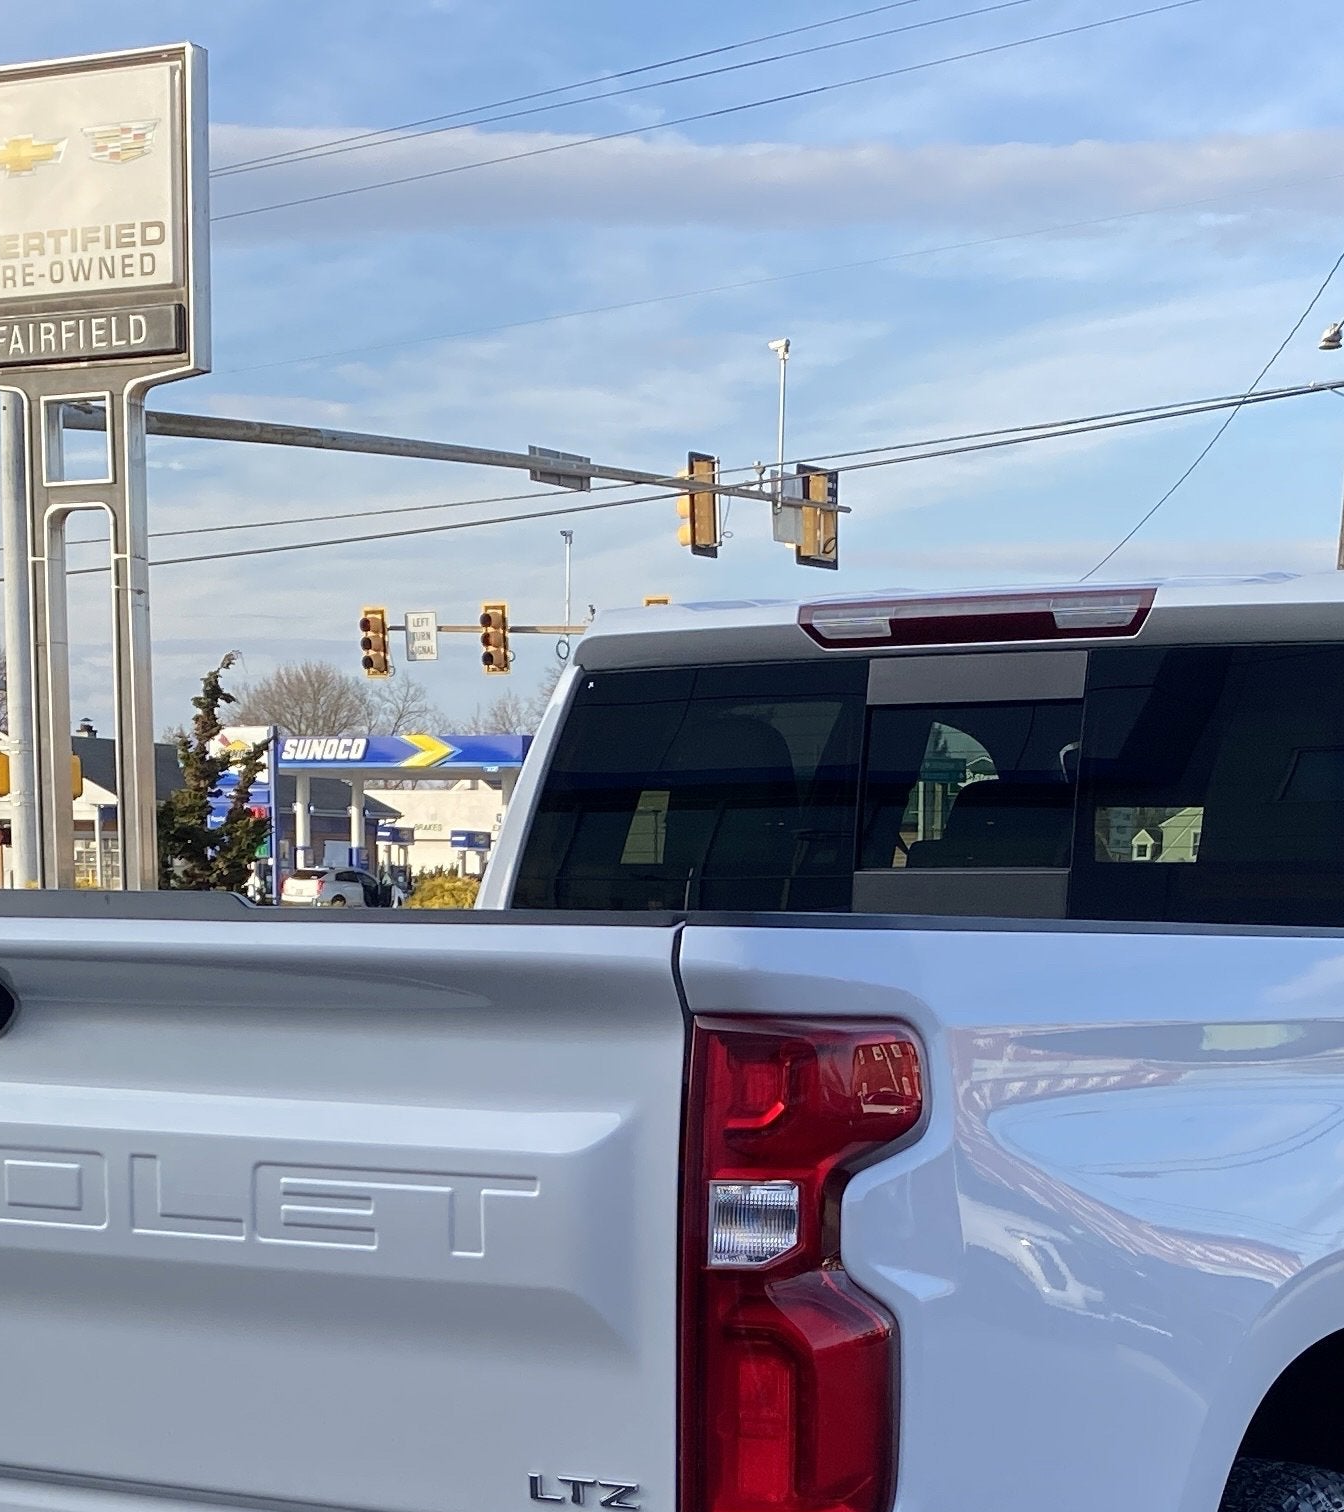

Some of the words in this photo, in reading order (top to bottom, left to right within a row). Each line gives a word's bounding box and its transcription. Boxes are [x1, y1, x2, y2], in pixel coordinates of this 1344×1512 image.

[412, 617, 430, 628] LEFT
[411, 631, 431, 641] TURN
[281, 738, 368, 761] SUNOCO
[414, 823, 443, 832] BRAKES
[527, 1472, 641, 1510] LTZ
